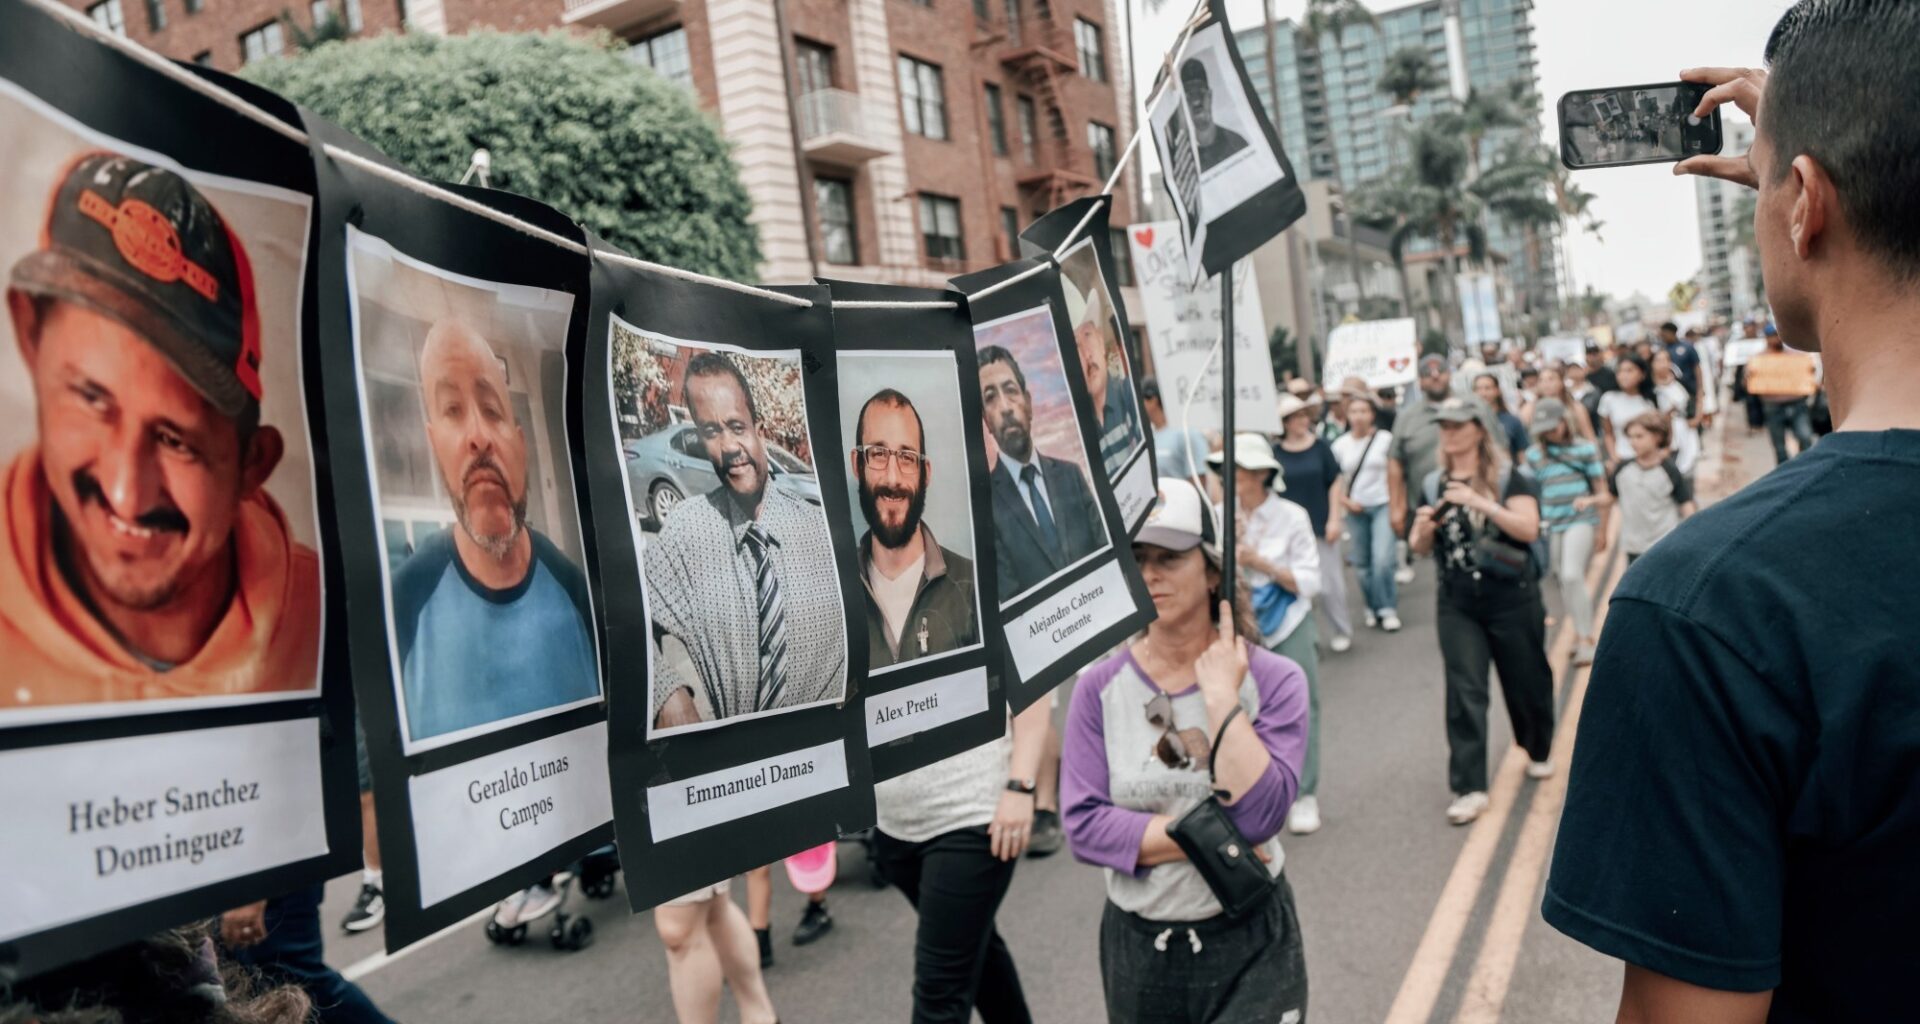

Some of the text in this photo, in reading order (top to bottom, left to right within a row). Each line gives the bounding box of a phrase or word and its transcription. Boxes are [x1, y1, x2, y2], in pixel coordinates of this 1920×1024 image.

[1028, 584, 1105, 639] Alejandro Cabrera
[1051, 612, 1092, 645] Clemente
[875, 693, 940, 726] Alex Pretti
[468, 755, 570, 805] Geraldo Lunas
[685, 758, 815, 806] Emmanuel Damas
[68, 778, 261, 835] Heber Sanchez
[498, 794, 554, 832] Campos
[94, 822, 245, 878] Dominguez
